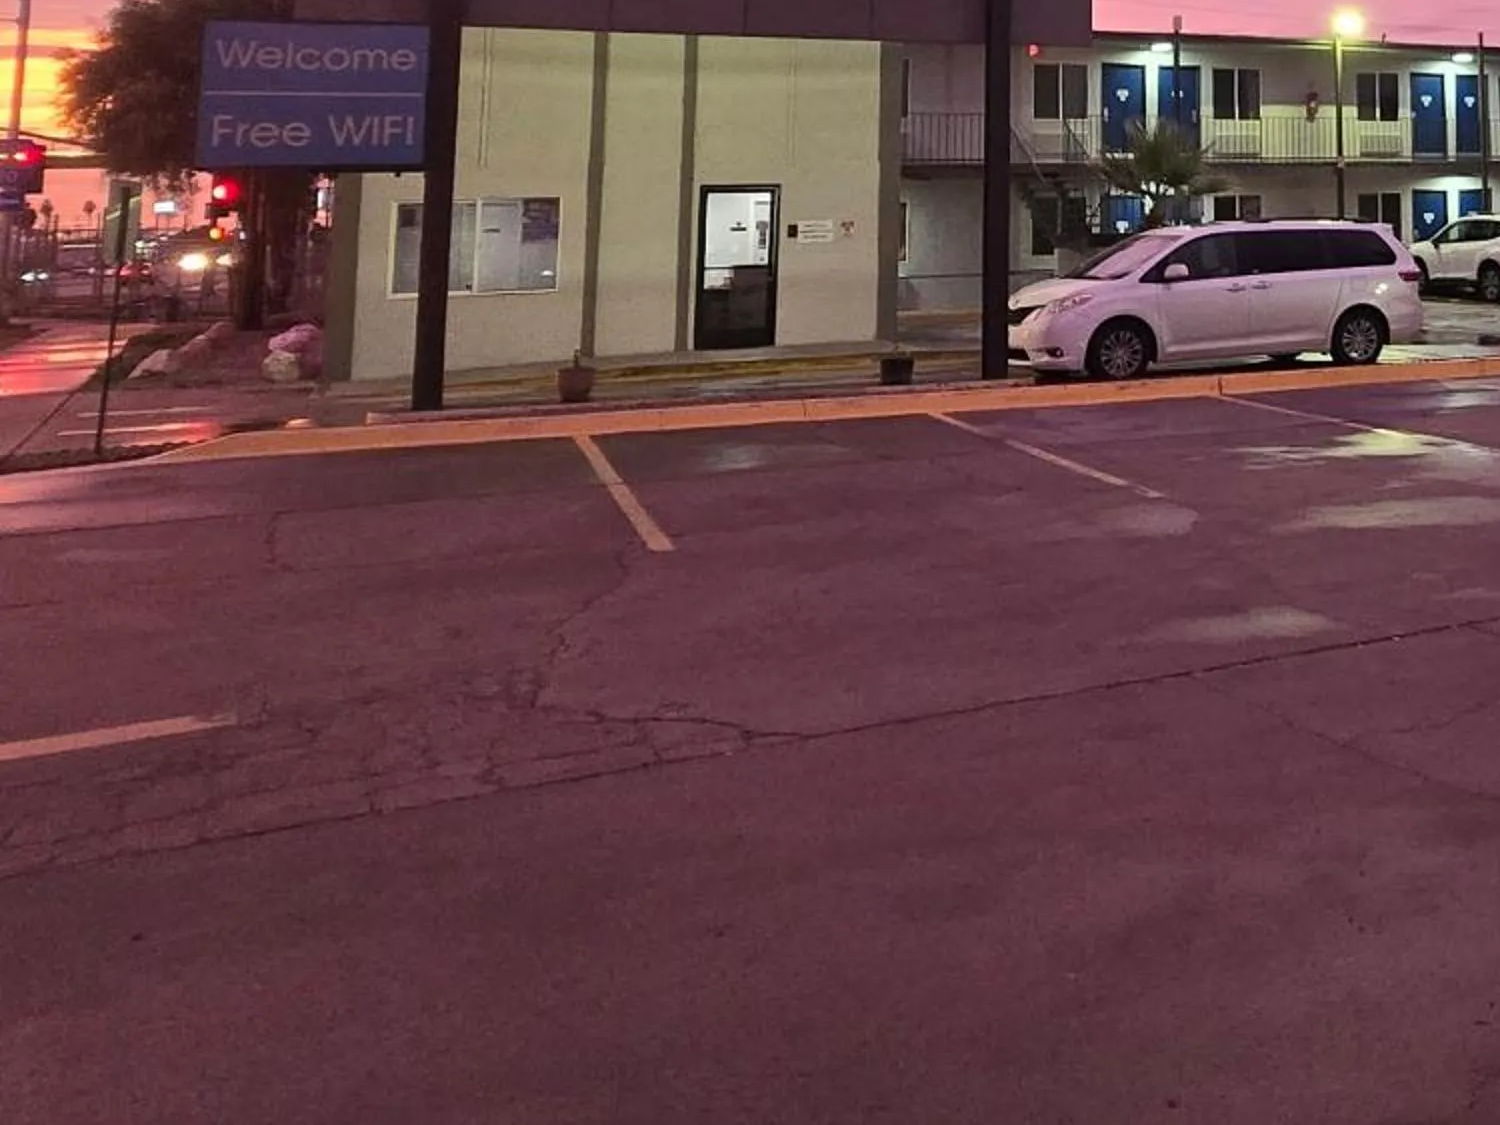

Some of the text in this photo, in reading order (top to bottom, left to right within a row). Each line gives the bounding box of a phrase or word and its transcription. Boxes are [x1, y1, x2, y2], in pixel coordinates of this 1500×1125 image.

[215, 39, 417, 71] Welcome
[211, 114, 414, 147] Free WIFI
